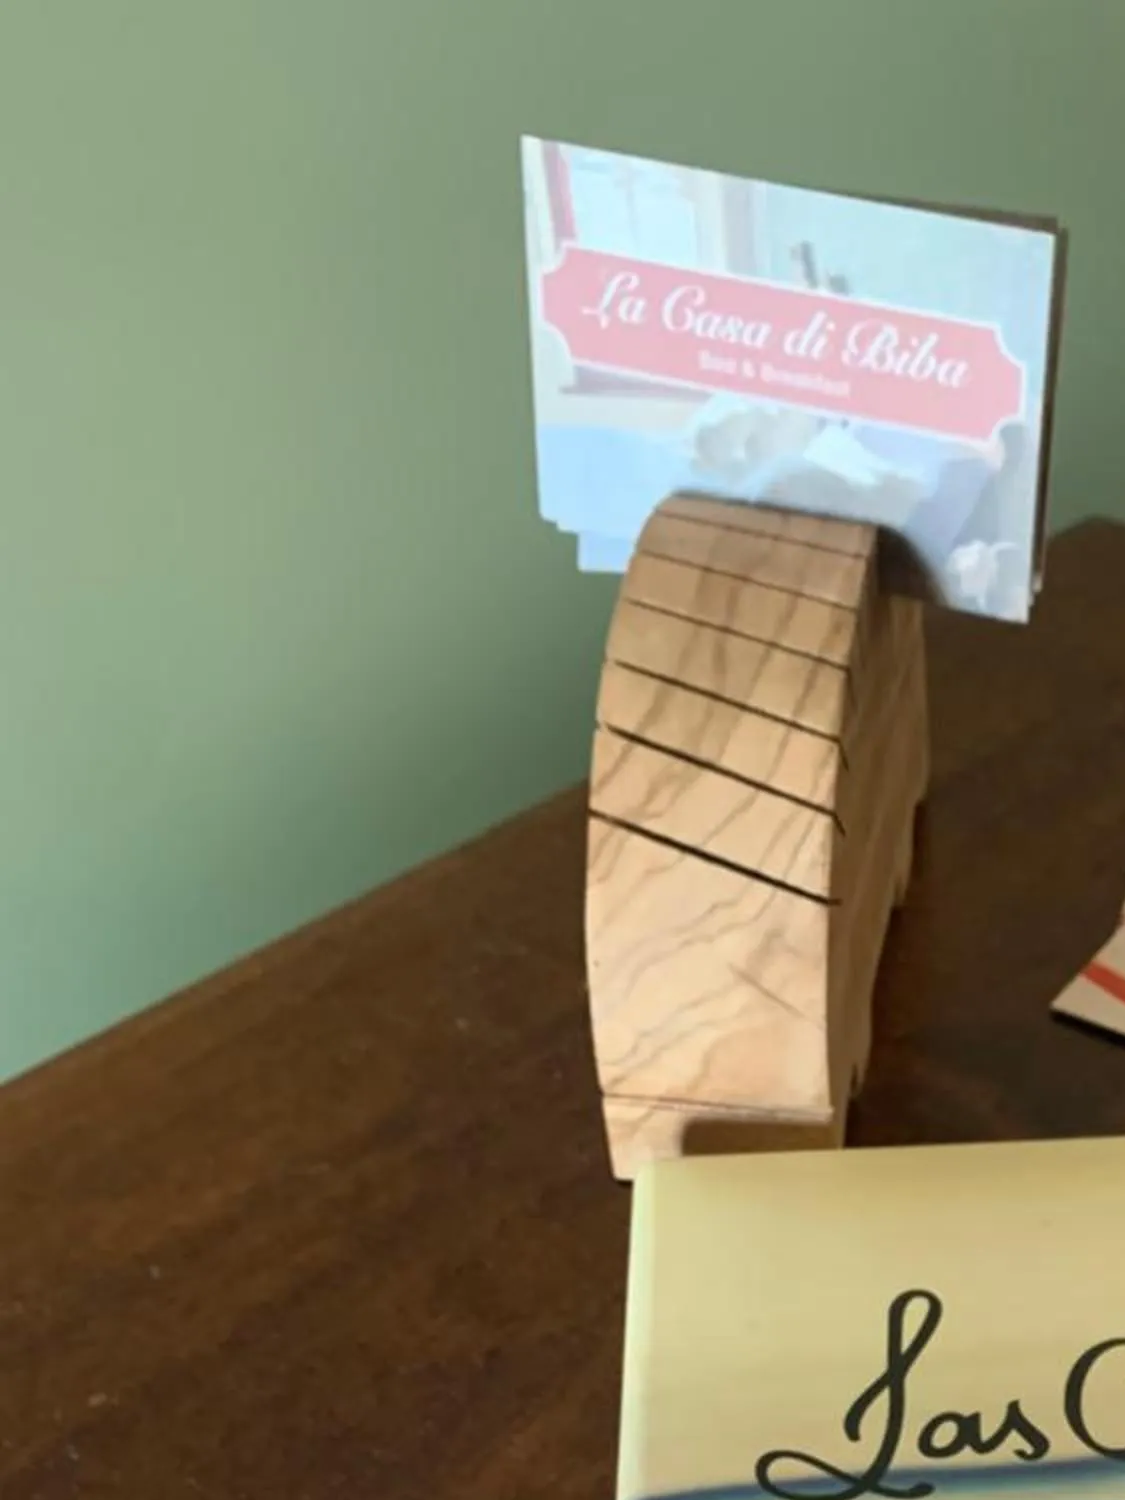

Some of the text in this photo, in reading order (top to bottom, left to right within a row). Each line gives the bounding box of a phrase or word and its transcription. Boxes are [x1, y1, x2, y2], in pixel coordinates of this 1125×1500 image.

[582, 270, 647, 330] La
[661, 284, 773, 349] Casa
[783, 310, 836, 361] di
[841, 318, 970, 388] Biba
